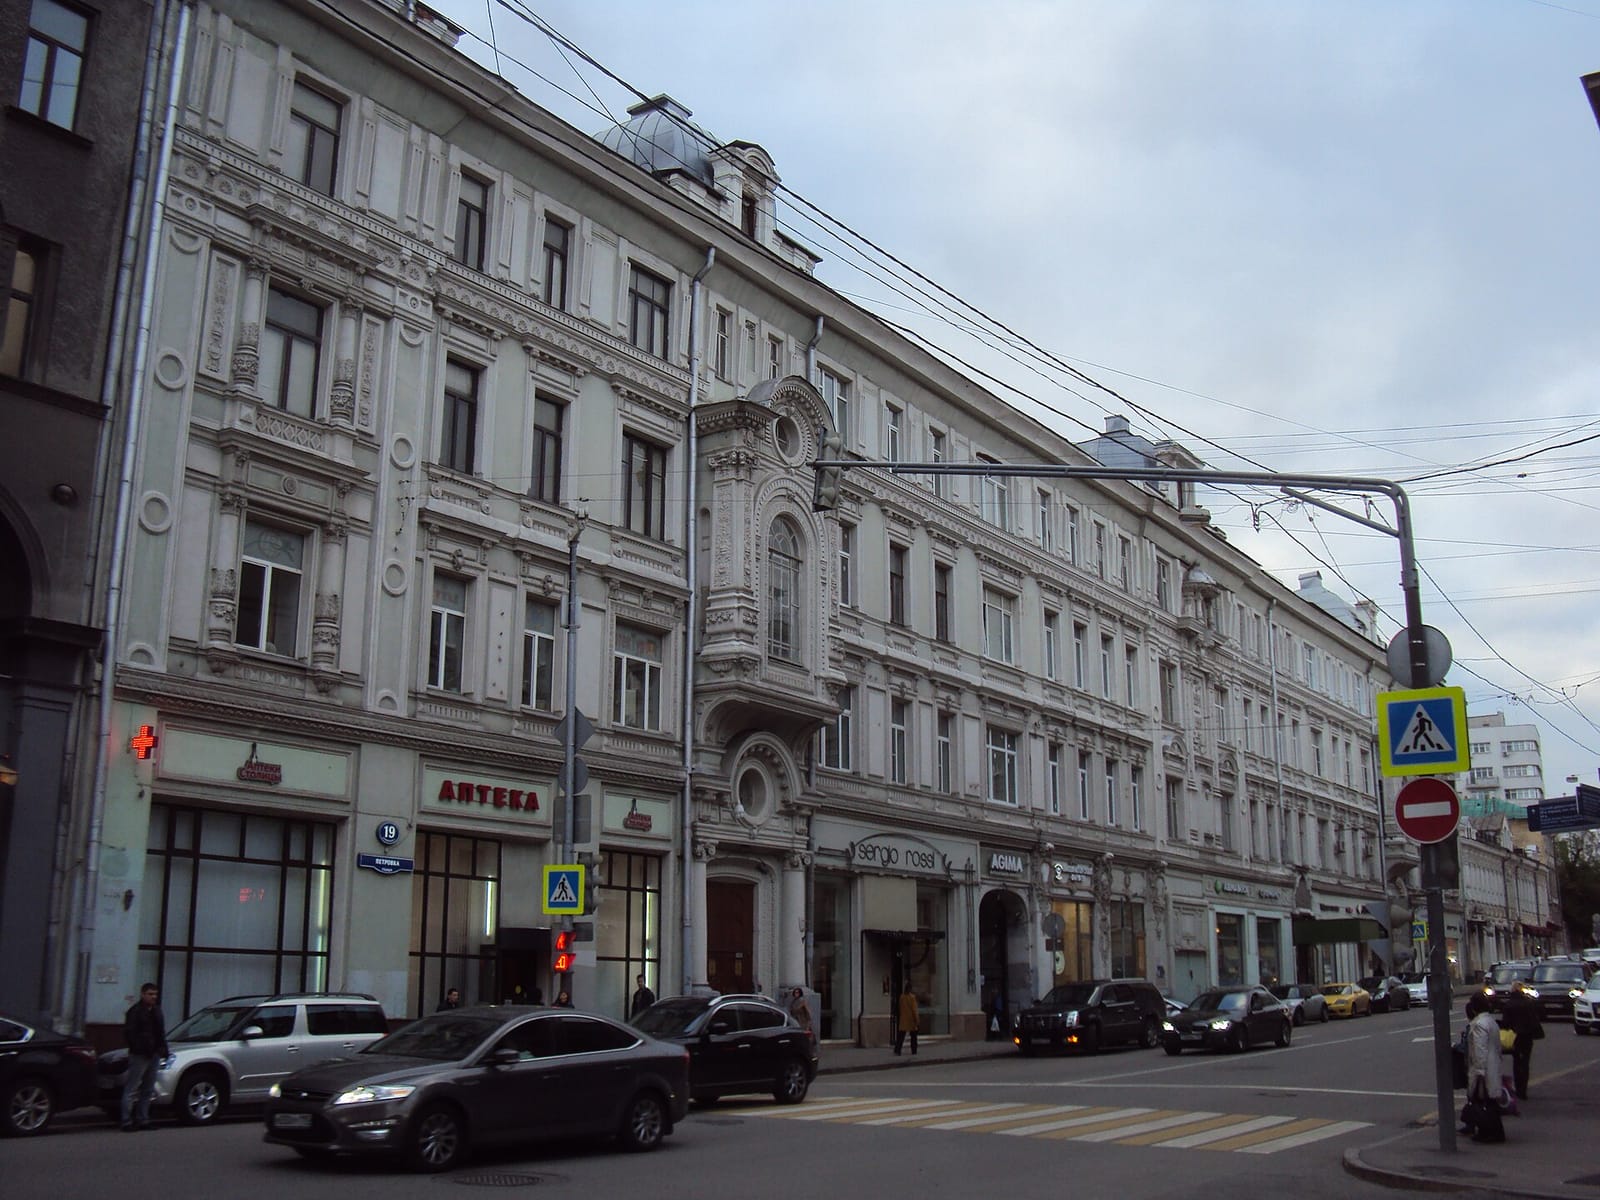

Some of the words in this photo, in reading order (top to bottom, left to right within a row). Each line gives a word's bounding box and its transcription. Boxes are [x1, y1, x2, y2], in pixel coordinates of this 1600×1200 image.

[438, 780, 540, 811] АПТЕКА
[383, 825, 396, 839] 19
[858, 843, 899, 867] sergio
[905, 849, 935, 869] rossi
[991, 853, 1024, 873] AGIMA
